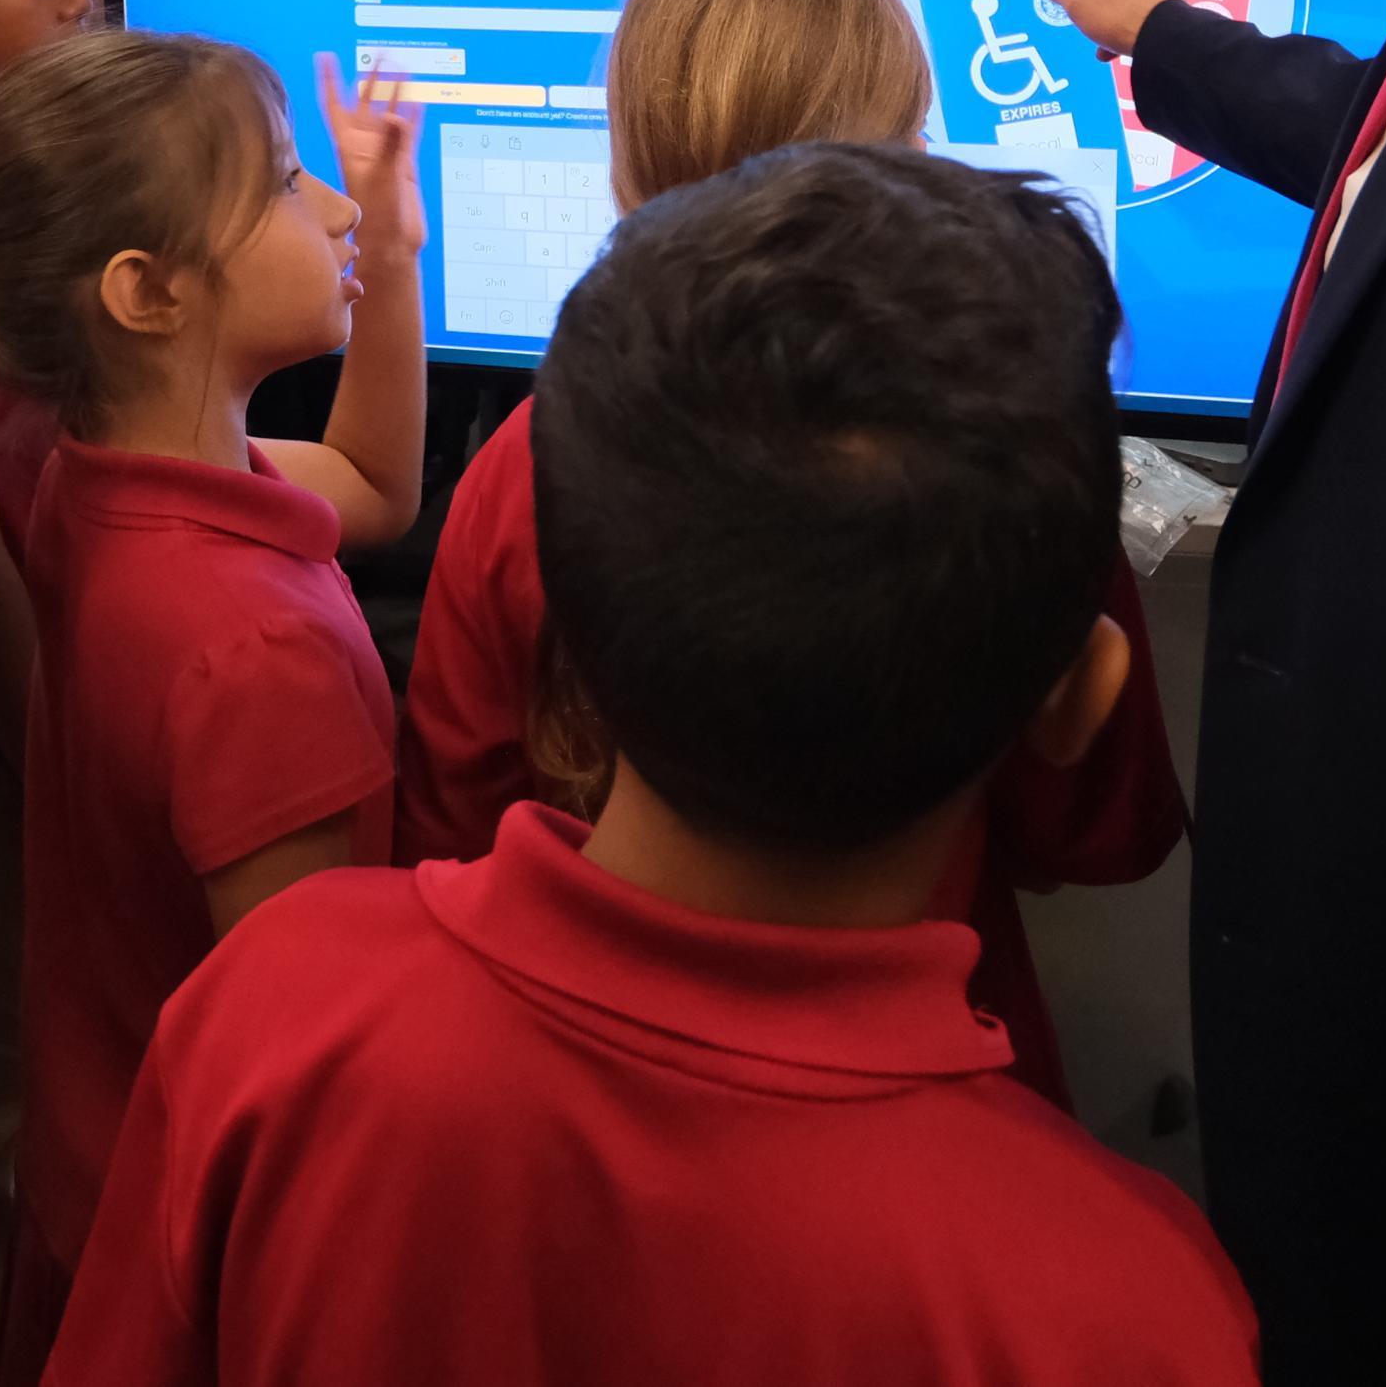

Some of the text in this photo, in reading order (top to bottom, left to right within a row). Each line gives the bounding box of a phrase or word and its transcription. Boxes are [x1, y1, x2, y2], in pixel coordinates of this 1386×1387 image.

[1000, 101, 1062, 122] EXPIRES
[581, 176, 590, 187] 2
[520, 211, 529, 223] q
[542, 247, 550, 256] a
